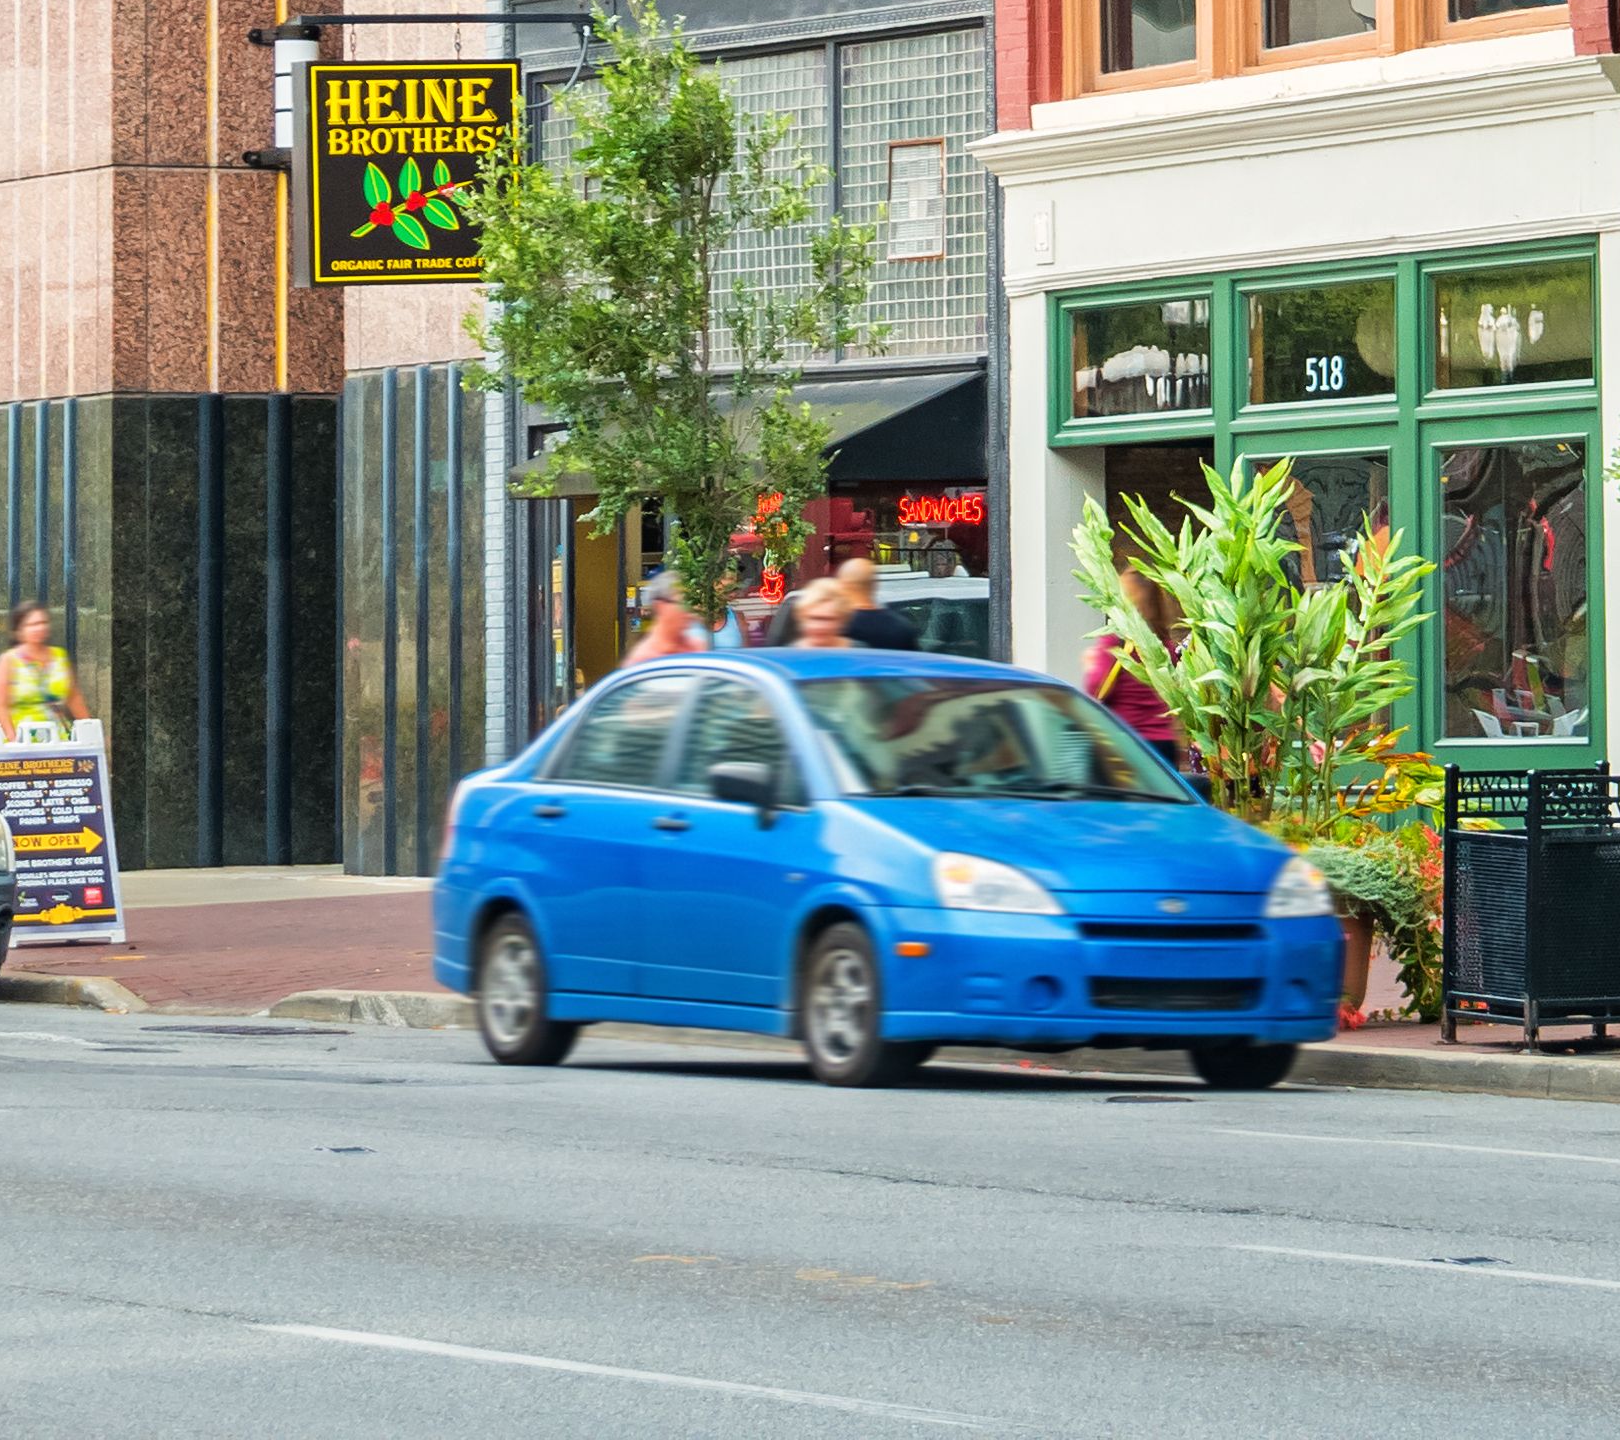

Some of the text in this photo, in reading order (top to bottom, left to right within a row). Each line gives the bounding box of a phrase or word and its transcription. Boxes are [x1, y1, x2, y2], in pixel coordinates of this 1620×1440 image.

[325, 78, 498, 125] HEINE
[328, 126, 504, 156] BROTHERS'
[331, 256, 485, 271] ORGANIC FAIR TRADE COFF
[1305, 355, 1343, 392] 518
[897, 495, 984, 525] SANDWICHES
[13, 835, 80, 847] NOW OPEN
